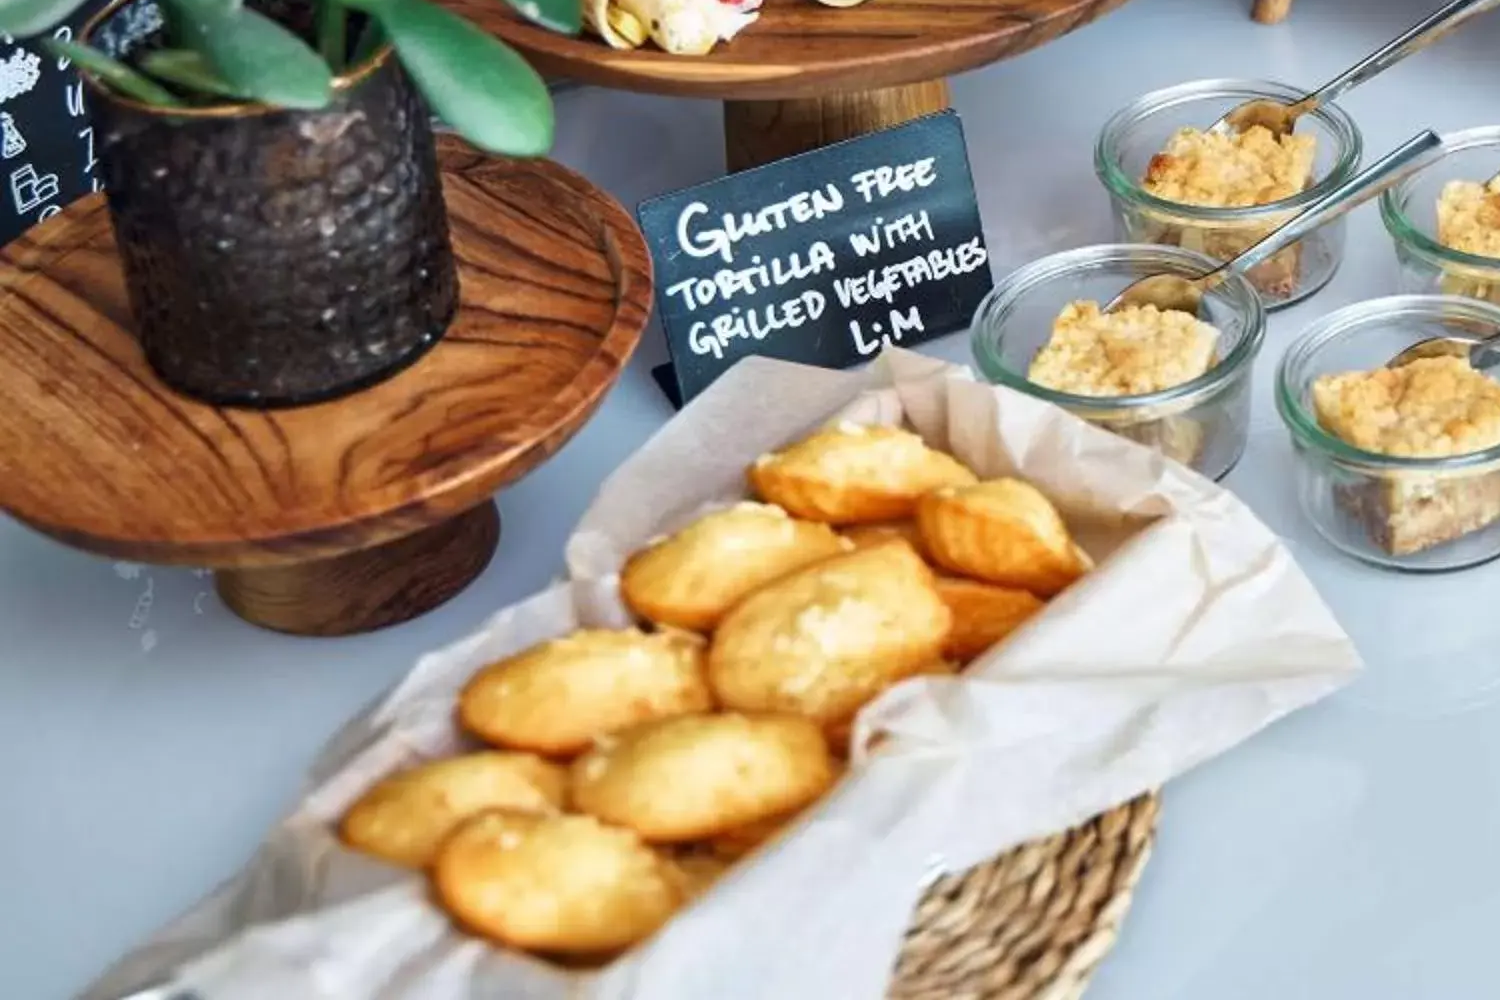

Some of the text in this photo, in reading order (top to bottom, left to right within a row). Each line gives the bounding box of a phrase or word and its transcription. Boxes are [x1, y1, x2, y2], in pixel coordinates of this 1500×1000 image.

[665, 210, 935, 311] TORTILLA WITH
[676, 157, 938, 263] GLUTEN FREE
[688, 236, 988, 359] GRILLED VEGETABLES
